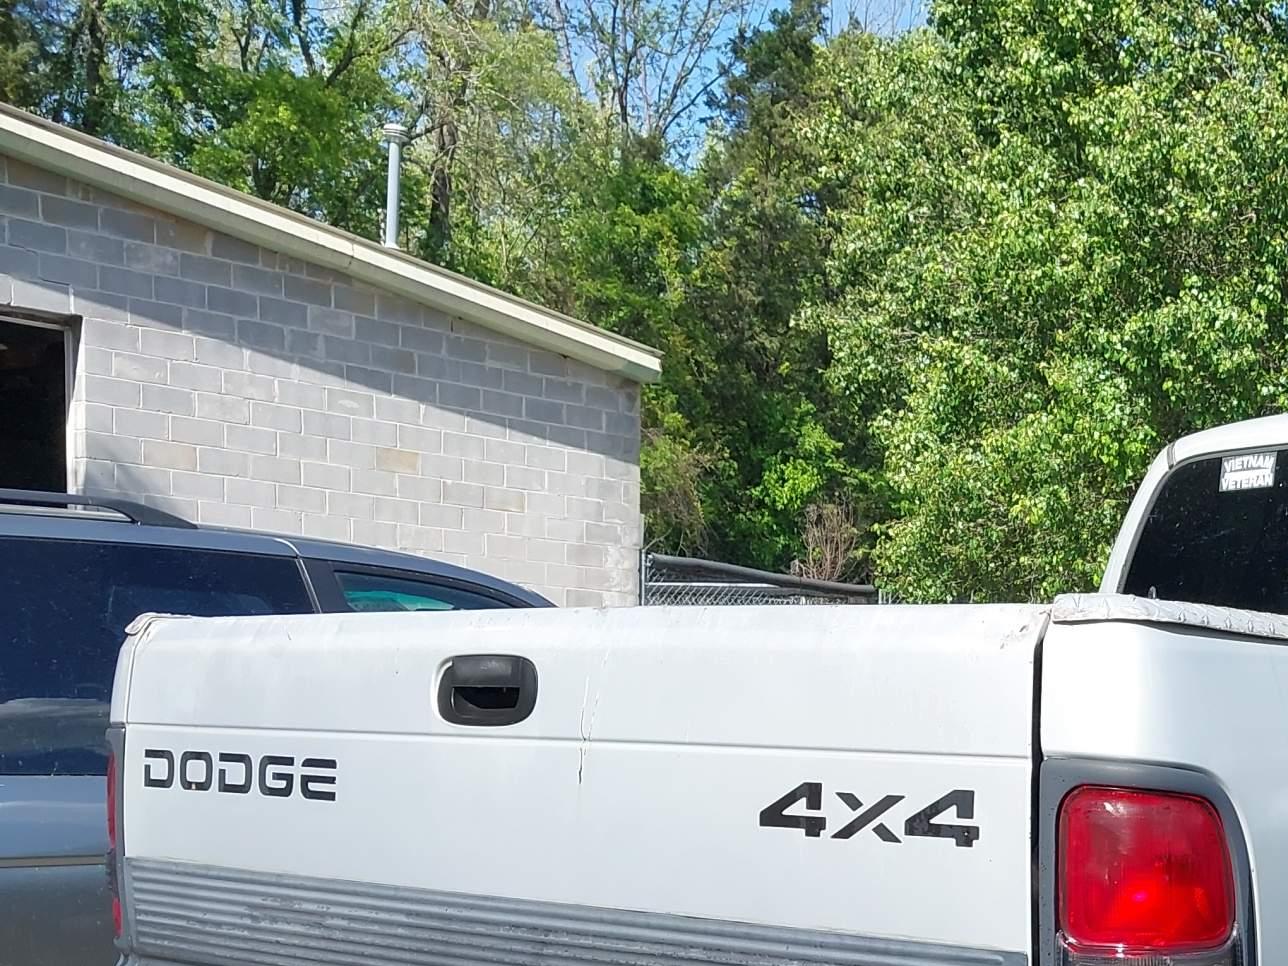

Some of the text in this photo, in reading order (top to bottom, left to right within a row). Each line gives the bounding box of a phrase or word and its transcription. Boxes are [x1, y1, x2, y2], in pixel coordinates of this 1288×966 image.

[1223, 454, 1275, 473] VIETNAM
[1221, 472, 1275, 490] VETERAN
[144, 749, 336, 801] DODGE
